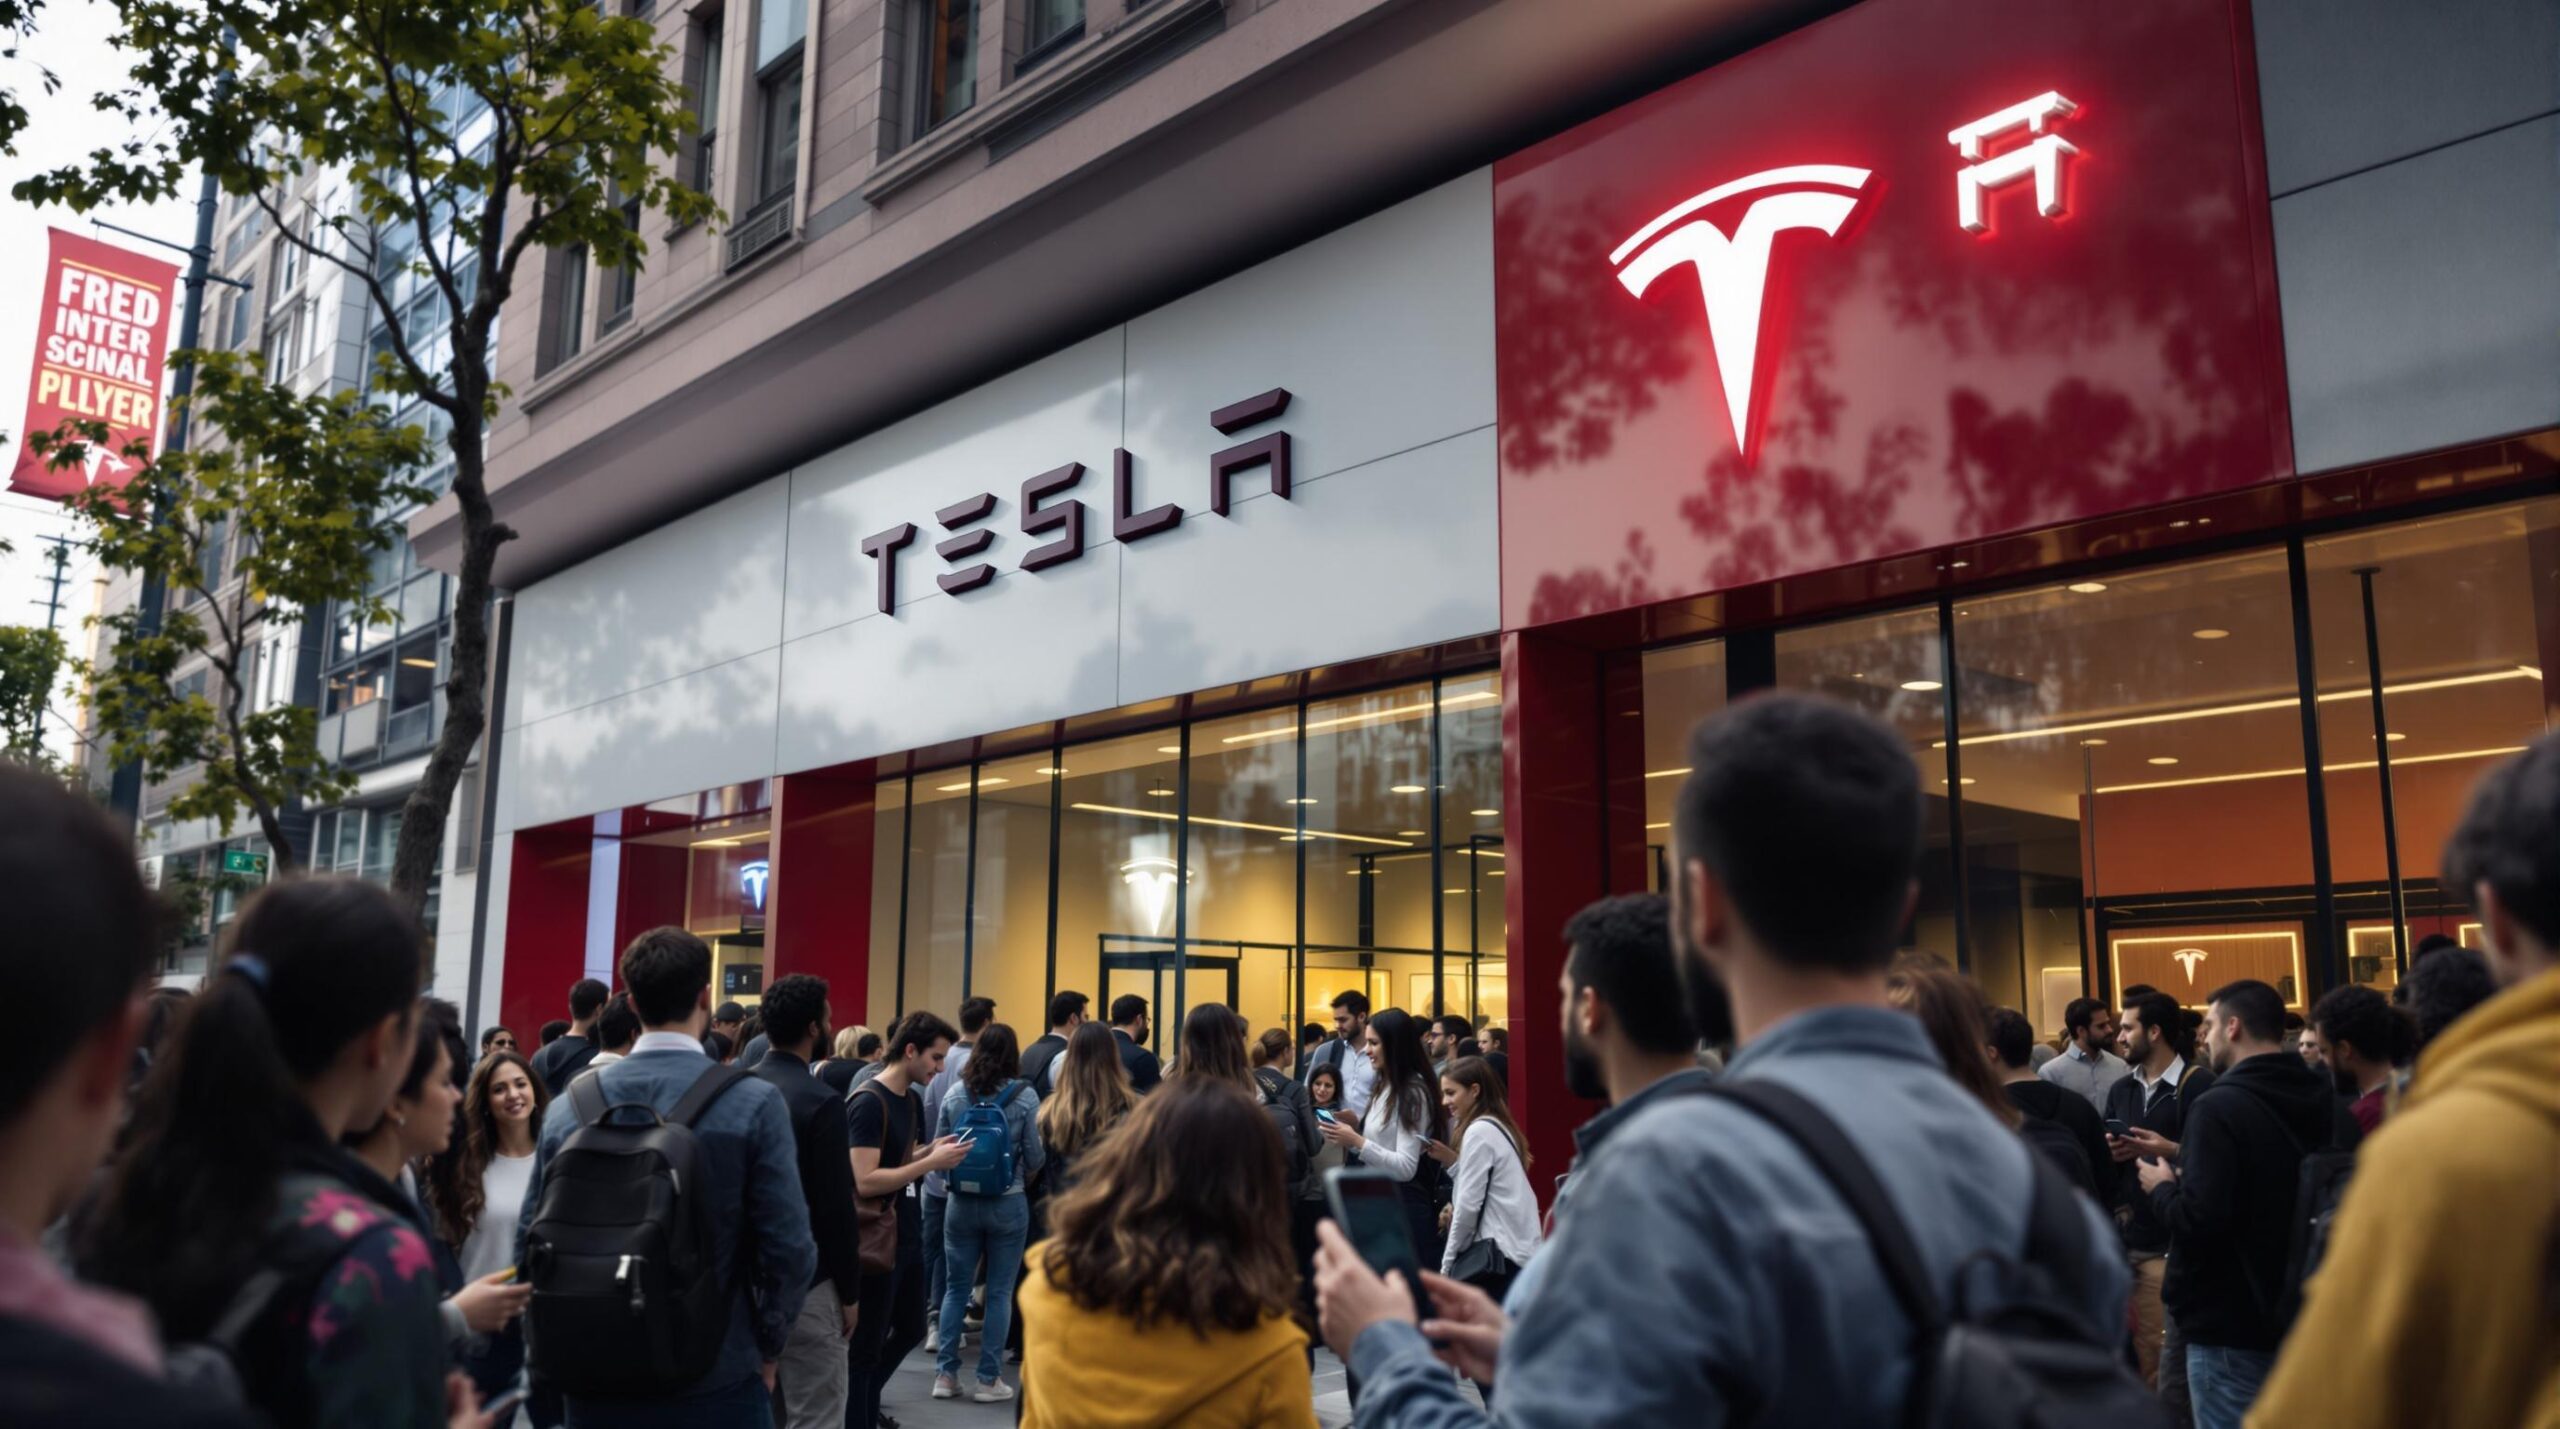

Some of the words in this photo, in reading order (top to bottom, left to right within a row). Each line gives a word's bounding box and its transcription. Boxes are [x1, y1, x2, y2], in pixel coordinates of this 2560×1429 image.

[58, 266, 160, 328] FRED
[45, 335, 153, 388] SCINAL
[54, 306, 151, 357] INTER
[37, 369, 154, 430] PLLYER
[861, 387, 1293, 617] TESLA
